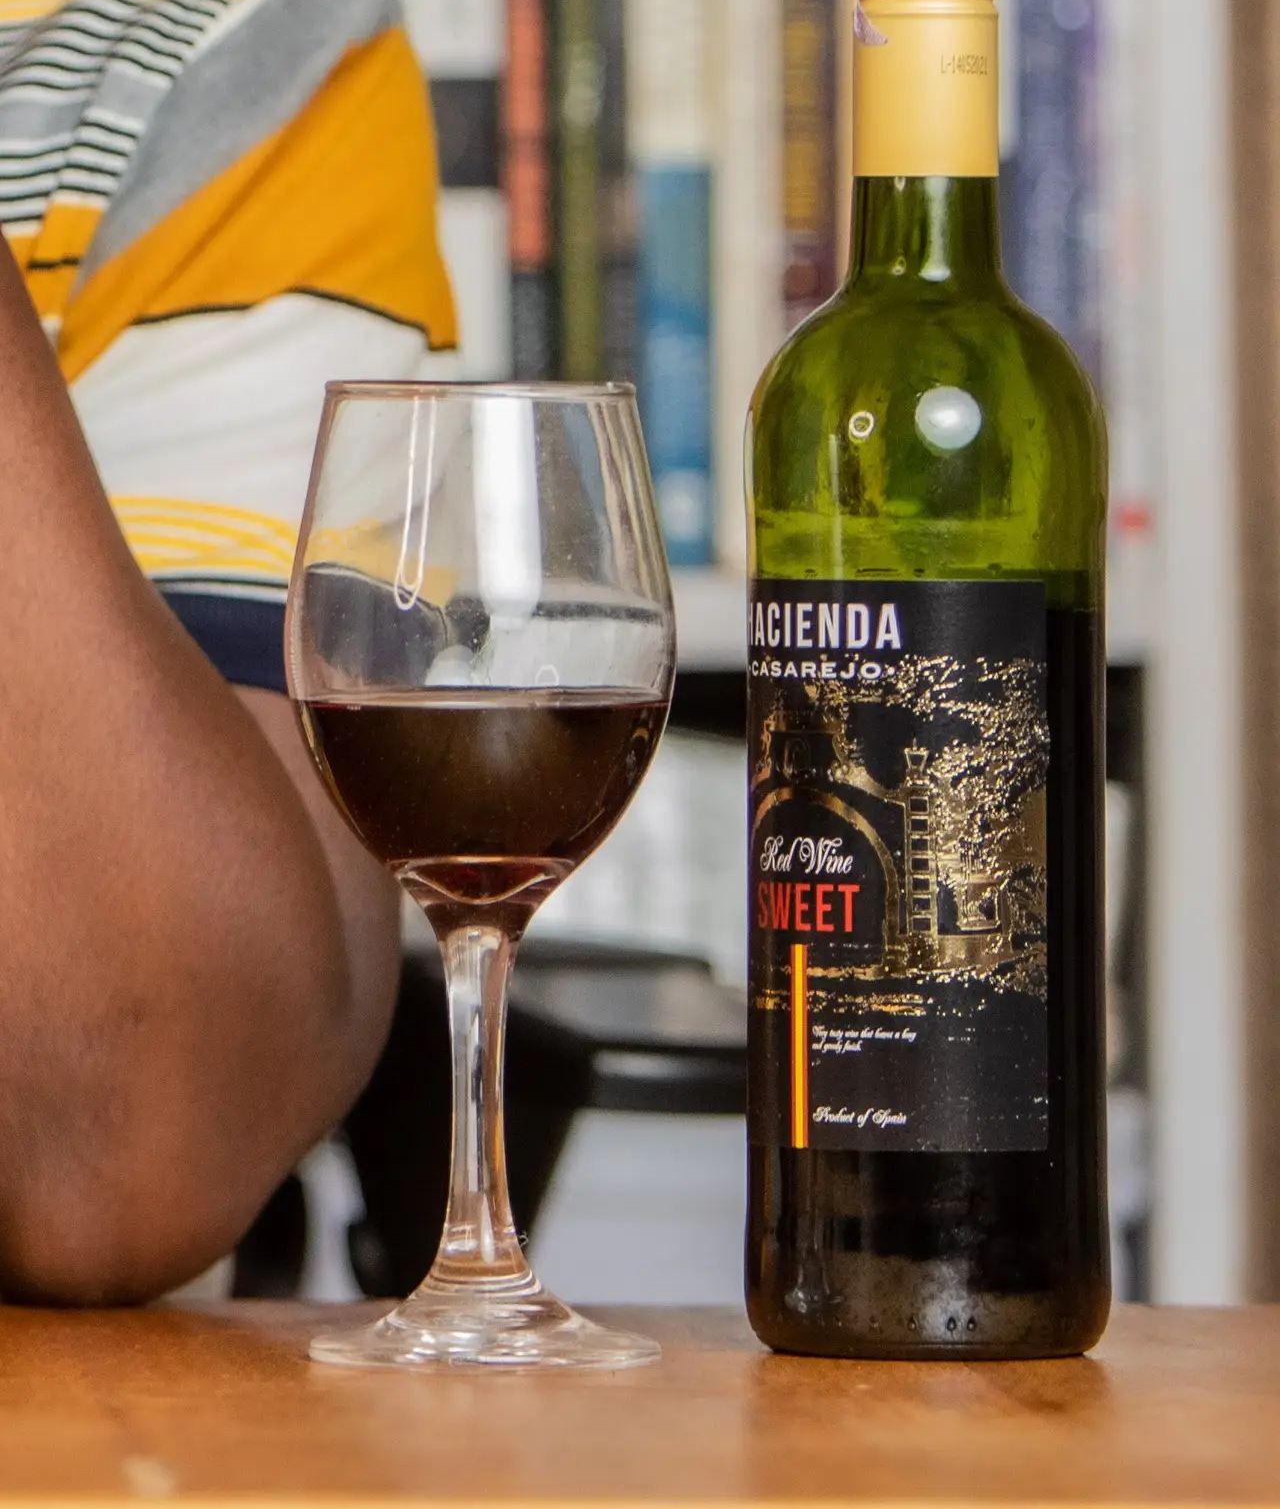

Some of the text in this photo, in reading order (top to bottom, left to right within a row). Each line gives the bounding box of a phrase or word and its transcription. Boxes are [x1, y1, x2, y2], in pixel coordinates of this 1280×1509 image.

[760, 835, 853, 874] Red Wine
[758, 882, 860, 932] SWEET
[812, 1107, 907, 1129] Product of Spain
